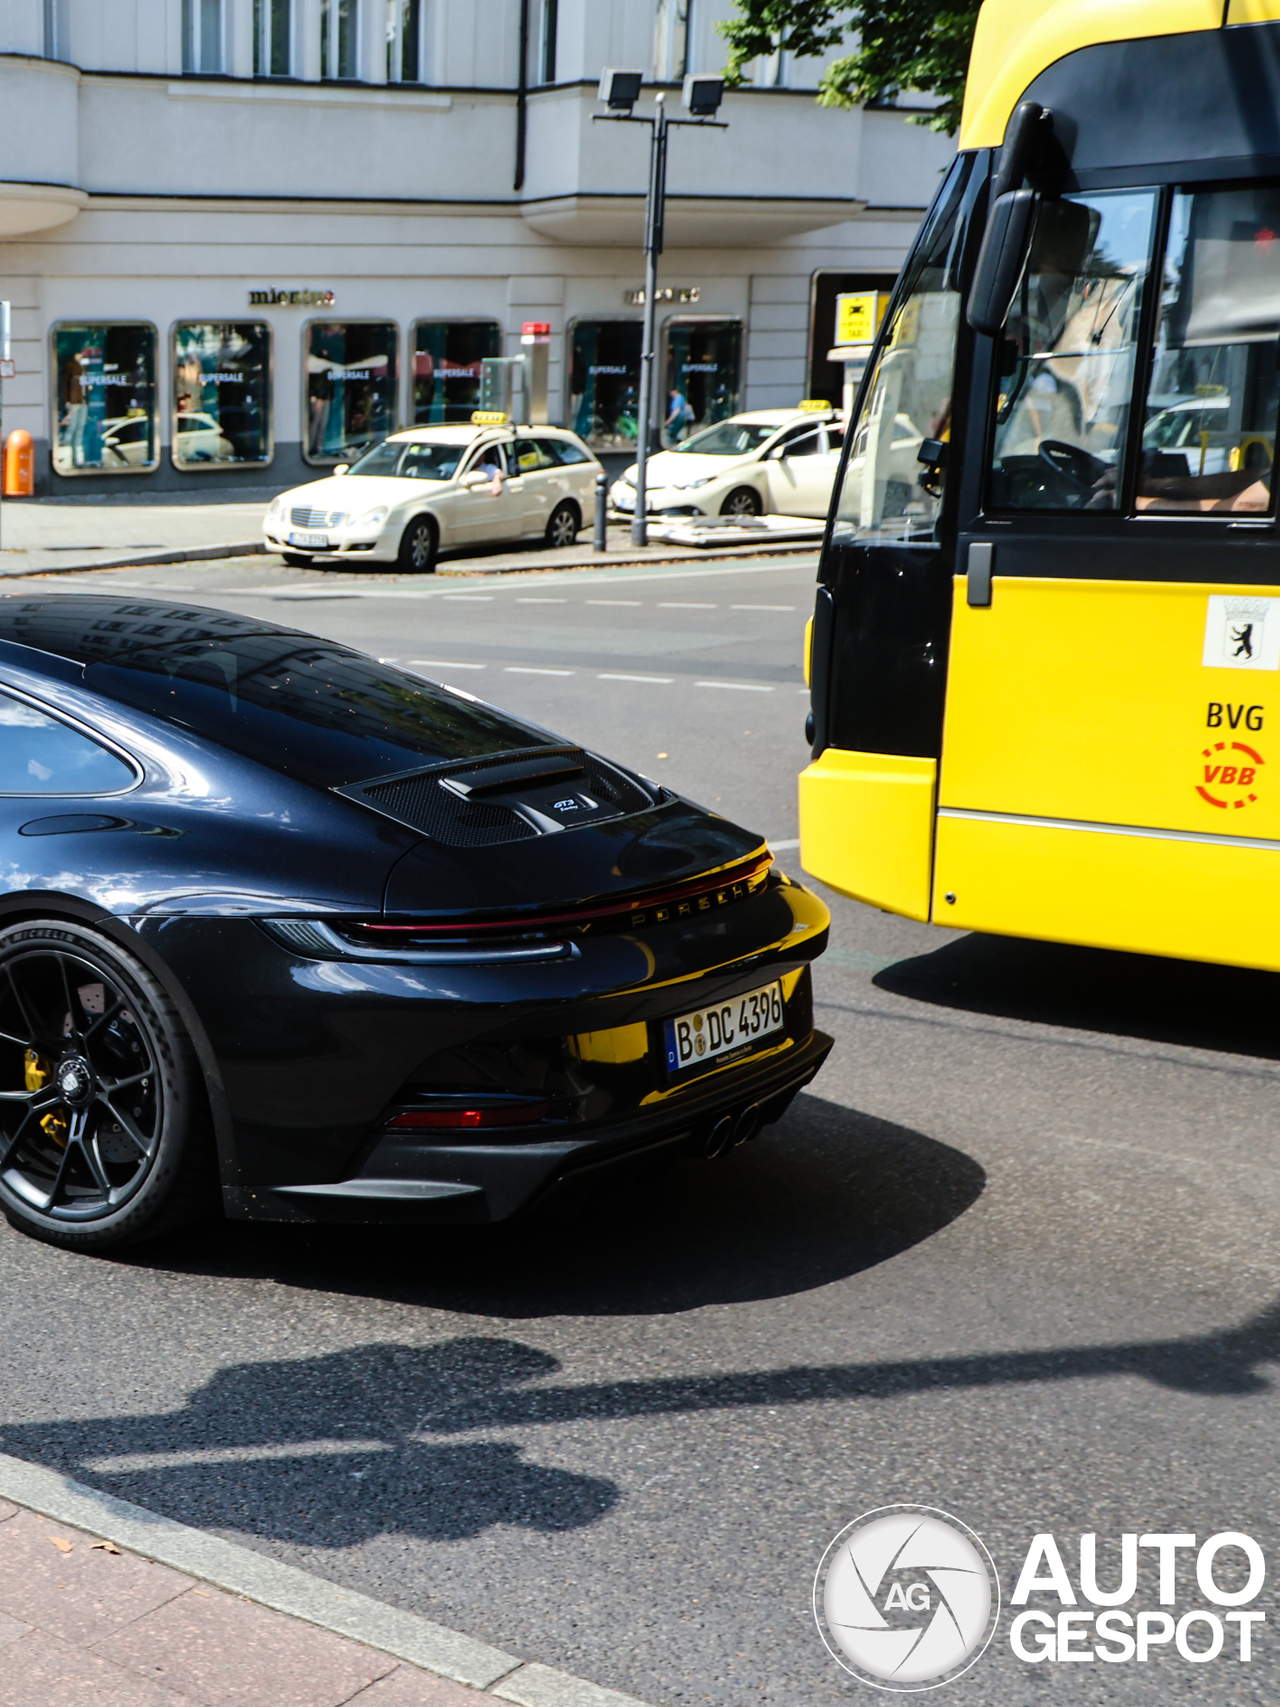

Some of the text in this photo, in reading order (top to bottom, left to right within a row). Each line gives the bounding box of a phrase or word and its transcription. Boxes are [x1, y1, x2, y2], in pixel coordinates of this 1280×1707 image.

[247, 285, 336, 305] mientus
[433, 368, 475, 378] SUPERSALE
[589, 365, 628, 375] SUPERSALE
[682, 363, 718, 373] SUPERSALE
[79, 375, 127, 386] SUPERSALE
[198, 372, 244, 384] SUPERSALE
[327, 370, 370, 380] SUPERSALE
[1206, 702, 1264, 731] BVG
[1204, 765, 1257, 786] VBB
[553, 799, 575, 808] GT3
[632, 881, 757, 927] PORSCHE
[12, 929, 75, 943] MICHELIN
[677, 988, 781, 1061] B DC 4396
[668, 1051, 675, 1063] D
